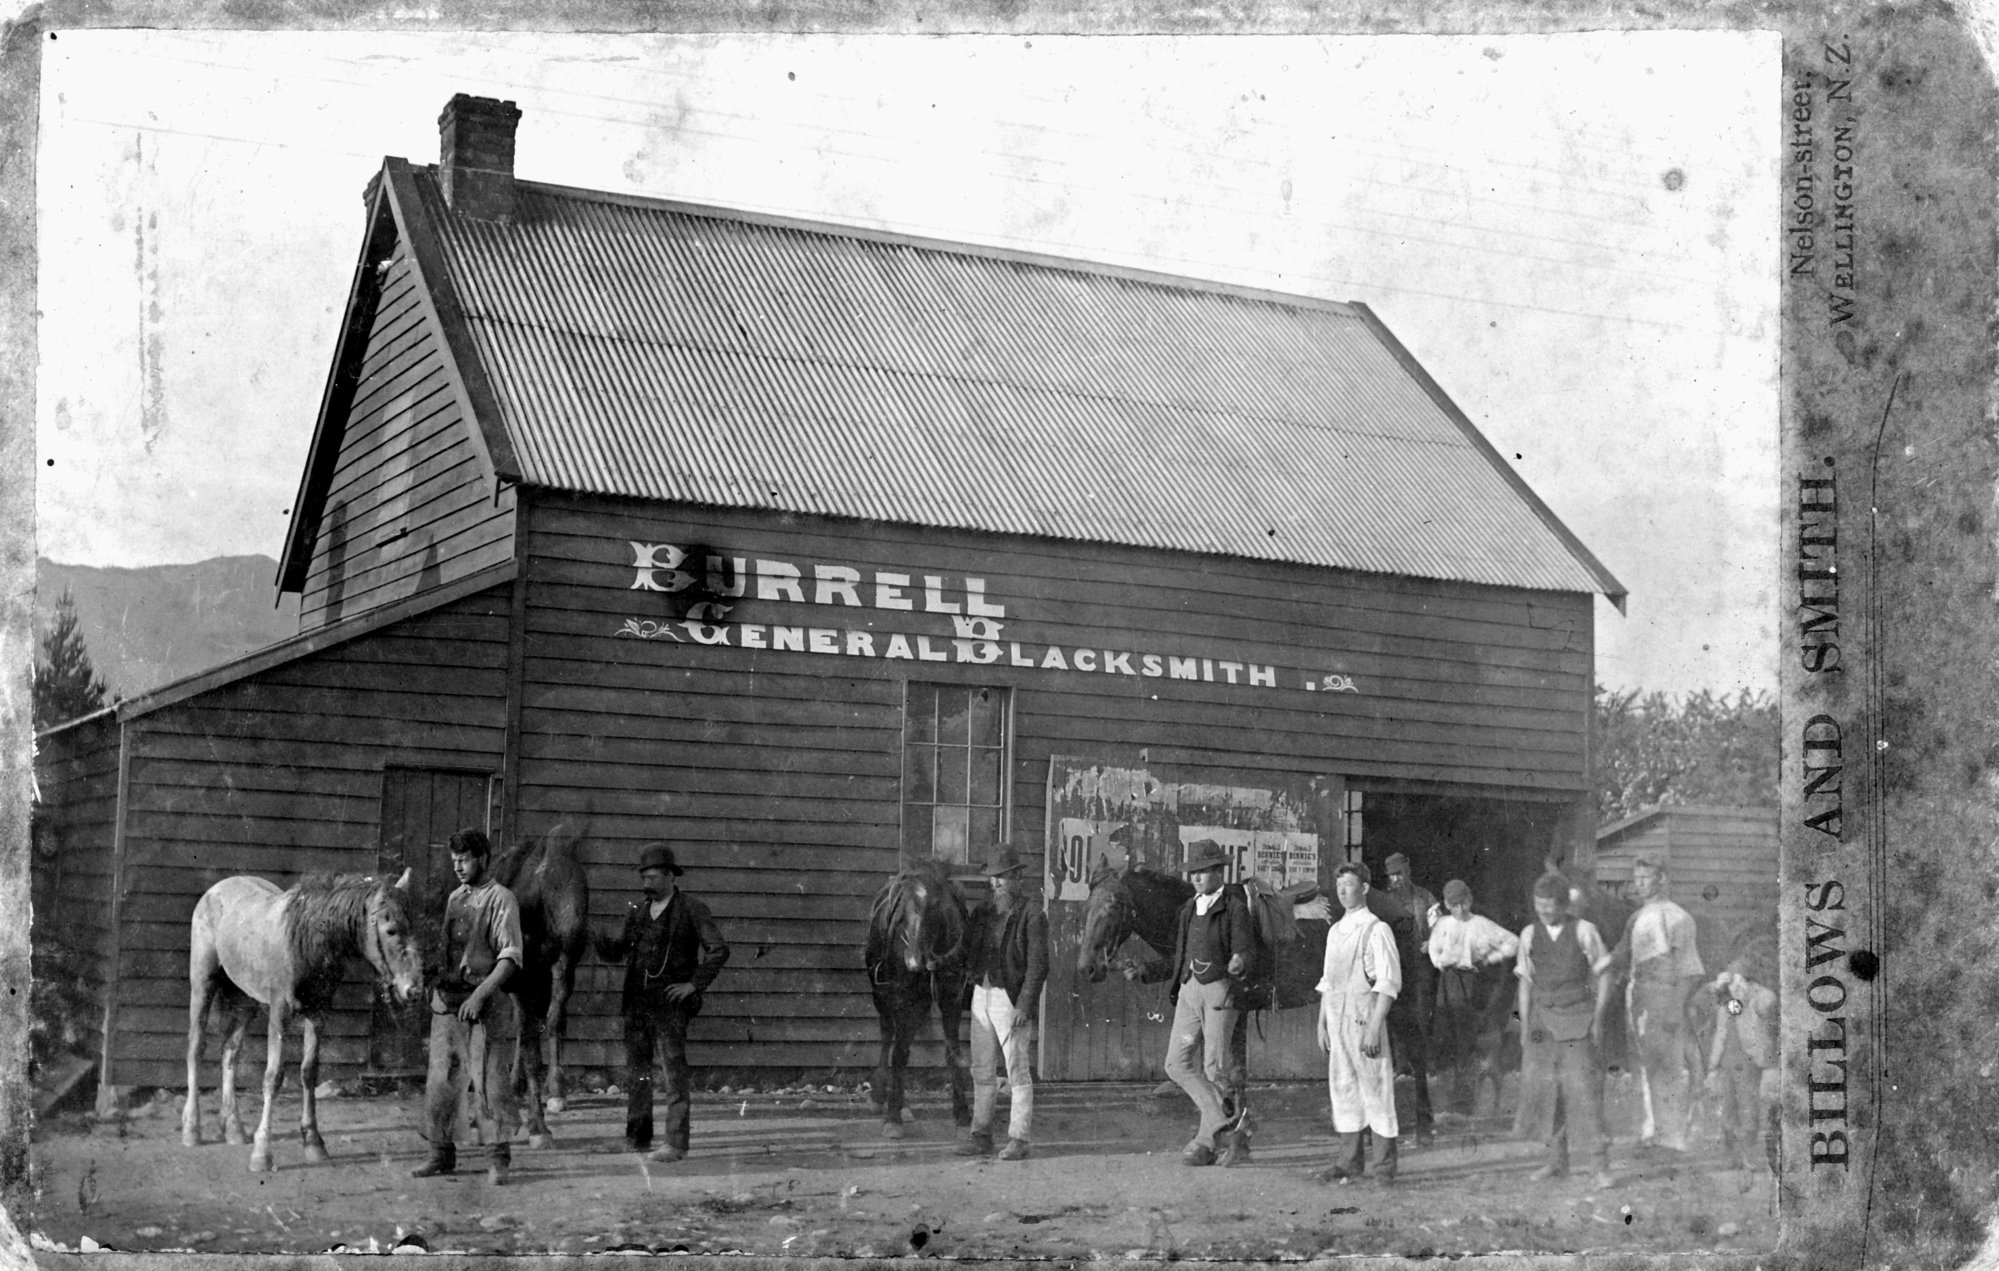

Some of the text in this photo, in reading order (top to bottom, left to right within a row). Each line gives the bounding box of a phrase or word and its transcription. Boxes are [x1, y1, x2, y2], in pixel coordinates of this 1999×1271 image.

[1823, 32, 1853, 103] N.Z.
[629, 541, 1005, 618] BURRELL
[677, 601, 948, 662] GENERAL
[1797, 455, 1849, 1172] BILLOWS AND SMITH.
